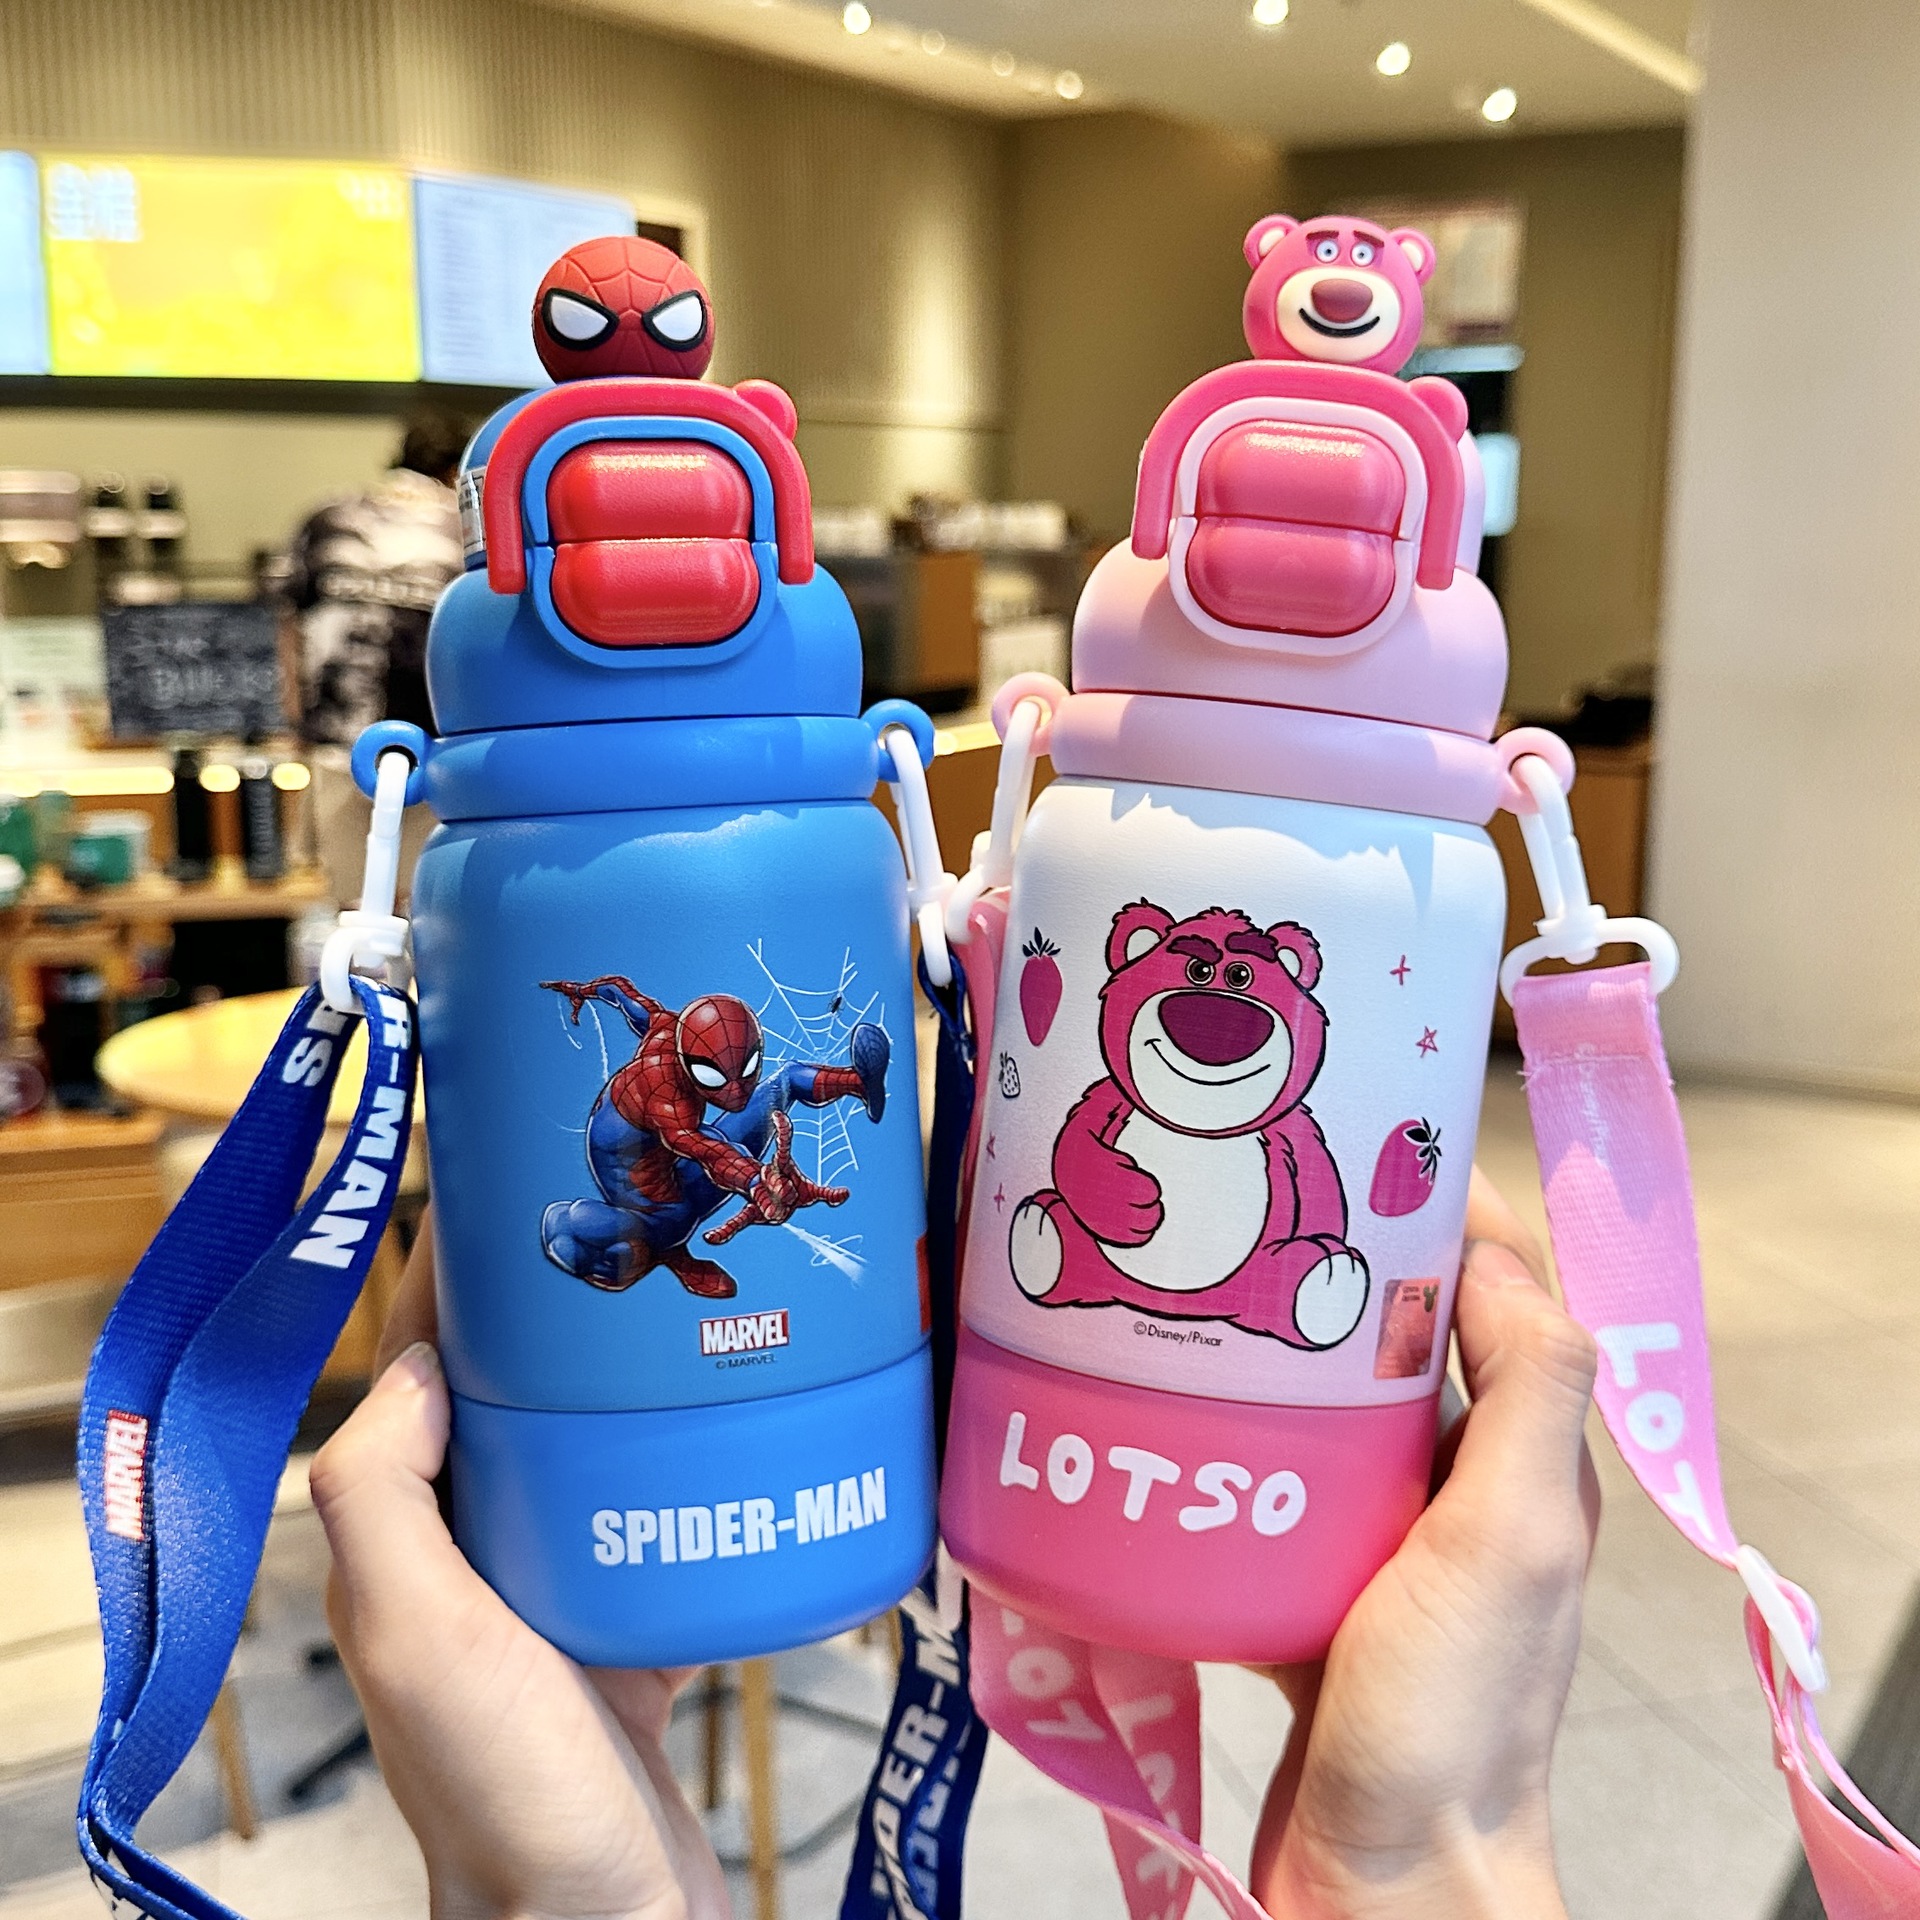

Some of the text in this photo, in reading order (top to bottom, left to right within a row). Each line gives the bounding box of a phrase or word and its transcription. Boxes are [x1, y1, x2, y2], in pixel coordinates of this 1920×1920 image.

[290, 976, 412, 1268] R-MAN
[701, 1313, 788, 1355] MARVEL
[728, 1352, 775, 1368] MARVEL
[1133, 1320, 1224, 1347] ©Disney/Pixar
[105, 1413, 149, 1542] MARVEL
[591, 1466, 887, 1566] SPIDER-MAN
[999, 1411, 1308, 1536] LOTSO
